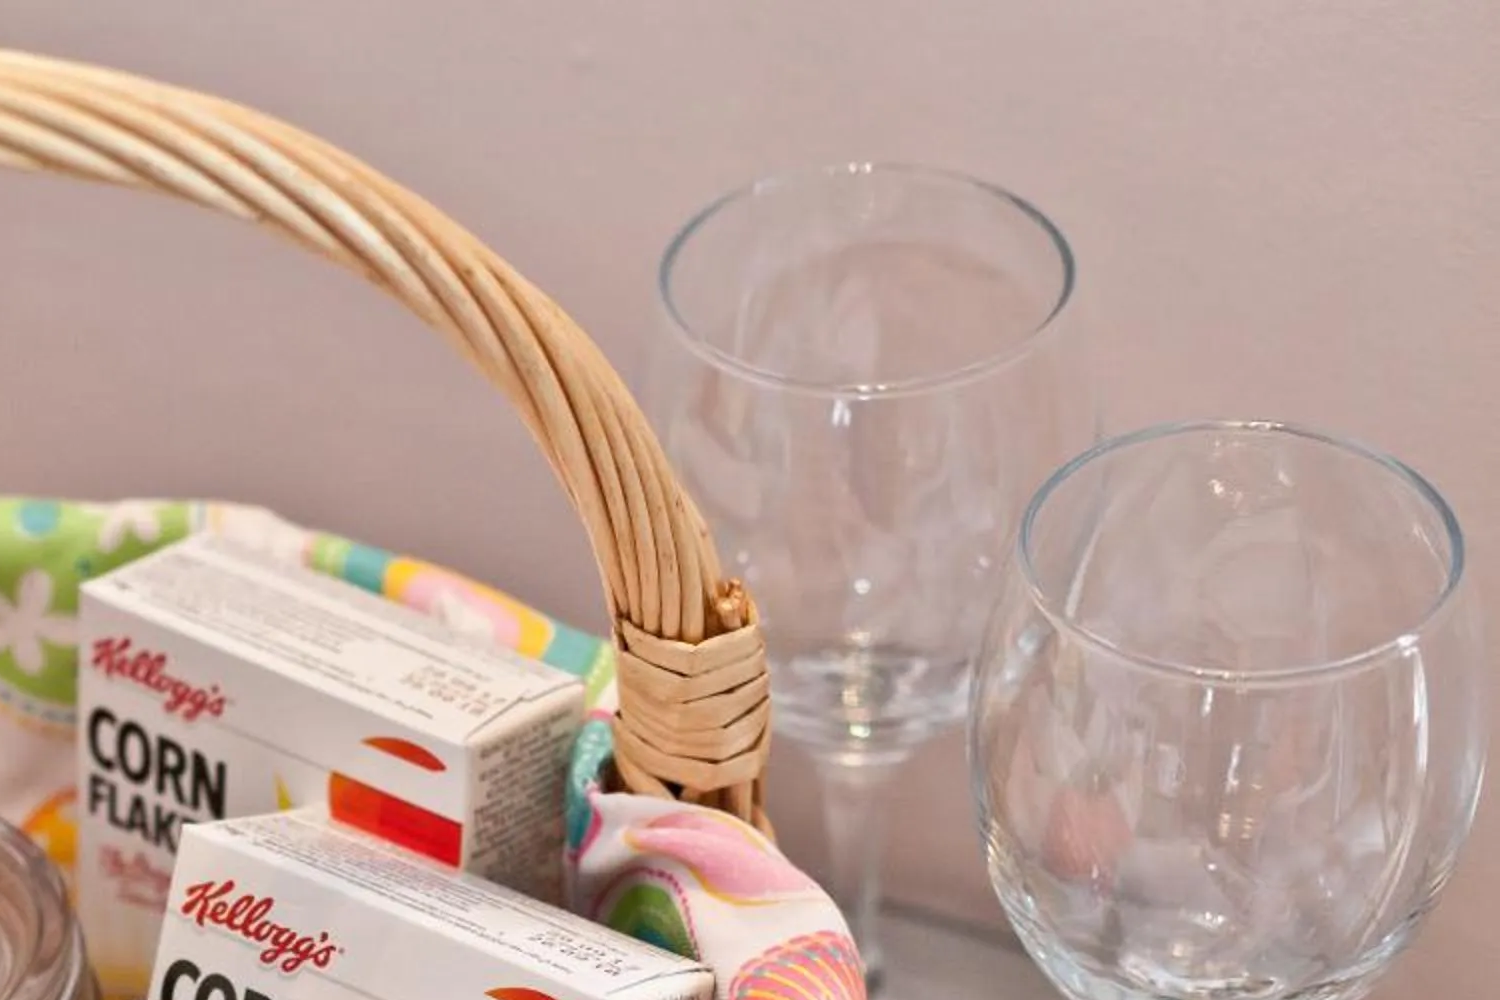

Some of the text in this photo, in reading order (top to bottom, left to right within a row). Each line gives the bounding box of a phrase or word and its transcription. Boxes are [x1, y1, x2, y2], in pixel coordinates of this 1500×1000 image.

[92, 637, 227, 722] Kellogg's
[88, 706, 226, 820] CORN
[88, 773, 199, 856] FLAK
[181, 880, 336, 973] Kellogg's
